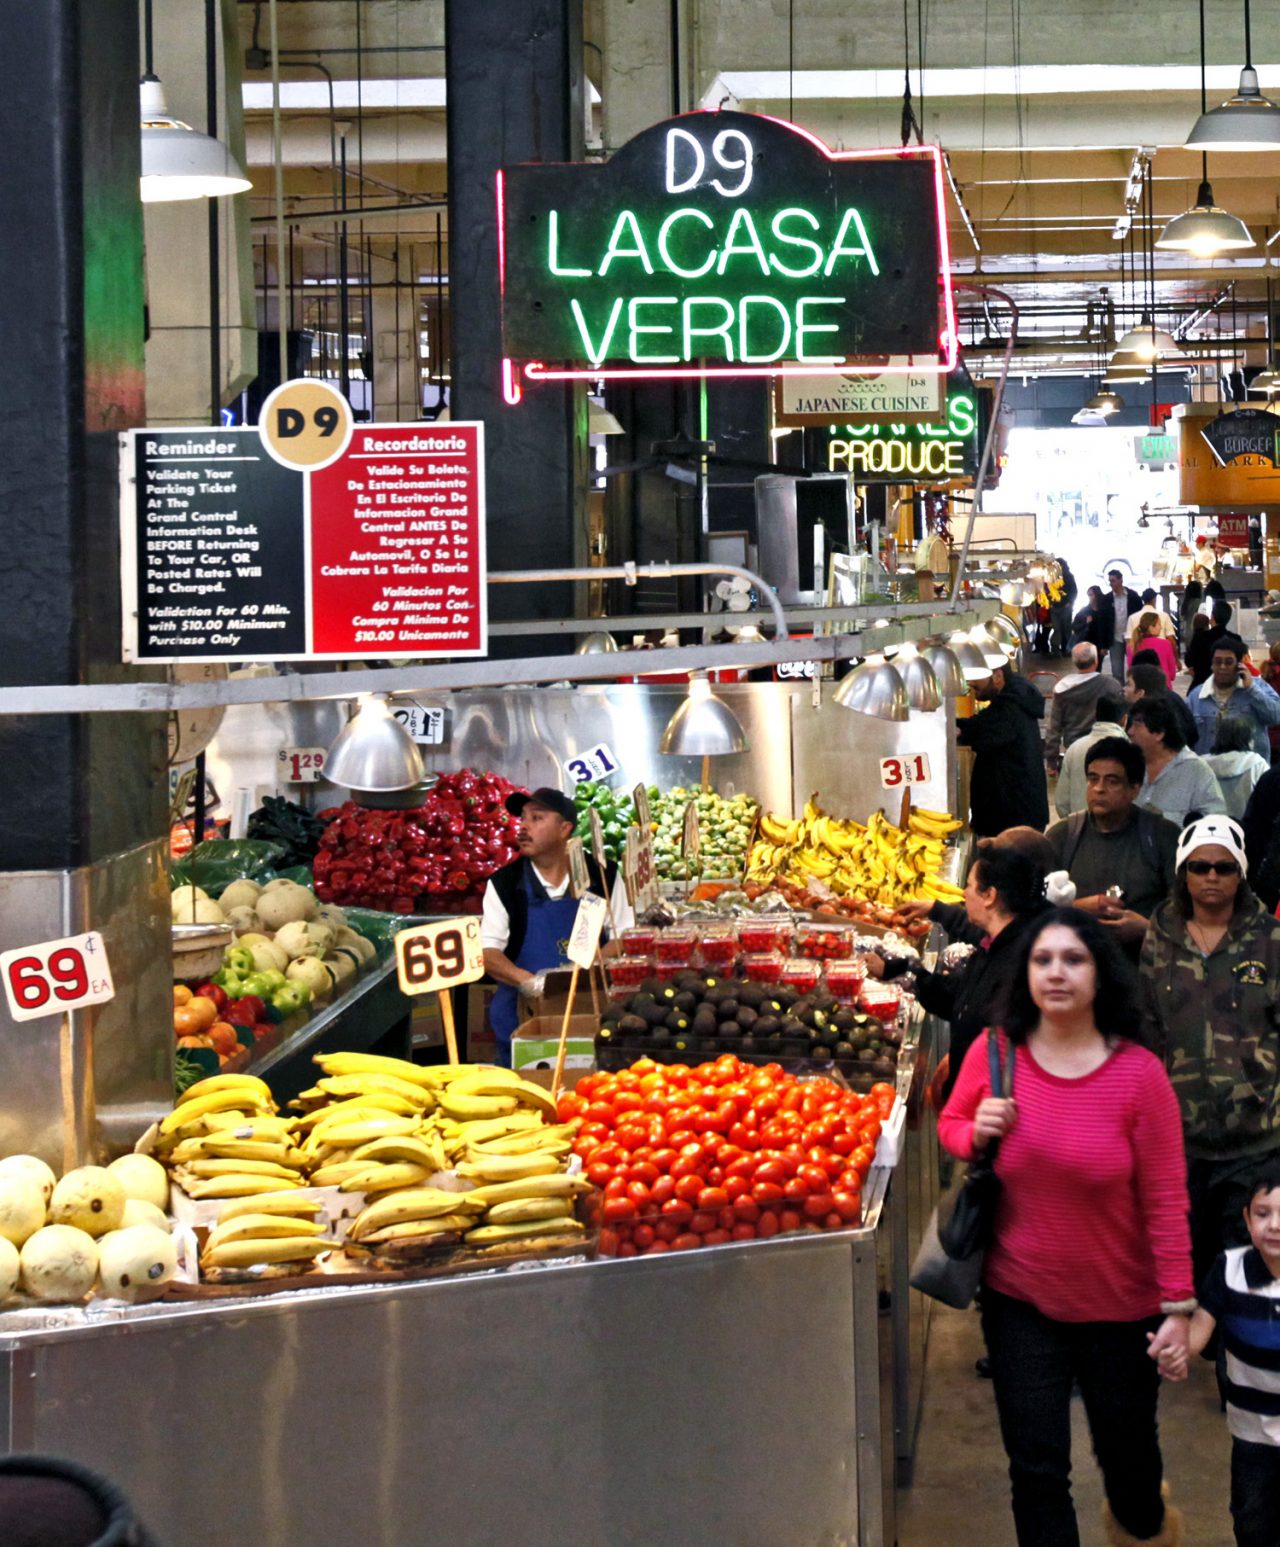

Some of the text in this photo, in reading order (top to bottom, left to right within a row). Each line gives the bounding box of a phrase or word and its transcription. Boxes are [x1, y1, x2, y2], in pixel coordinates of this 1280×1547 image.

[665, 128, 755, 198] D9
[570, 295, 847, 365] VERDE
[796, 396, 930, 412] JAPANESE CUISINE
[146, 439, 236, 455] Reminder
[363, 435, 467, 451] Recordatorio
[829, 439, 964, 474] PRODUCE
[146, 469, 234, 480] Validate Your
[367, 465, 404, 476] Valide
[409, 465, 424, 475] Su
[146, 483, 237, 496] Parking Ticket
[347, 479, 467, 490] De Estacionamiento
[147, 498, 189, 509] At The
[357, 492, 467, 504] En El Escritorio De
[147, 511, 238, 522] Grand Central
[354, 506, 468, 518] Informacion Grand
[147, 524, 258, 537] Information Desk
[361, 521, 468, 532] Central ANTES De
[1221, 519, 1247, 530] ATM
[147, 539, 260, 551] BEFORE Returning
[380, 535, 468, 548] Regresar A Su
[147, 553, 250, 565] To Your Car, OR
[349, 549, 468, 561] Automovil, O Se Le
[147, 567, 262, 579] Posted Rates Will
[320, 563, 469, 576] Cobrara La Tarifa Diaria
[147, 582, 226, 595] Be Charged.
[382, 585, 469, 597] Validacion Por
[148, 604, 290, 617] Validation For 60 Min.
[372, 601, 390, 611] 60
[393, 600, 441, 611] Minutos
[149, 619, 286, 632] with $10.00 Minimum
[352, 614, 469, 627] Compra Minima De
[149, 633, 241, 646] Purchase Only
[355, 629, 469, 642] $10.00 Unicamente
[568, 759, 593, 783] 3
[595, 748, 615, 772] 1
[883, 759, 903, 786] 3
[913, 755, 926, 782] 1
[402, 929, 465, 985] 69
[8, 947, 89, 1009] 69
[91, 978, 111, 994] EA
